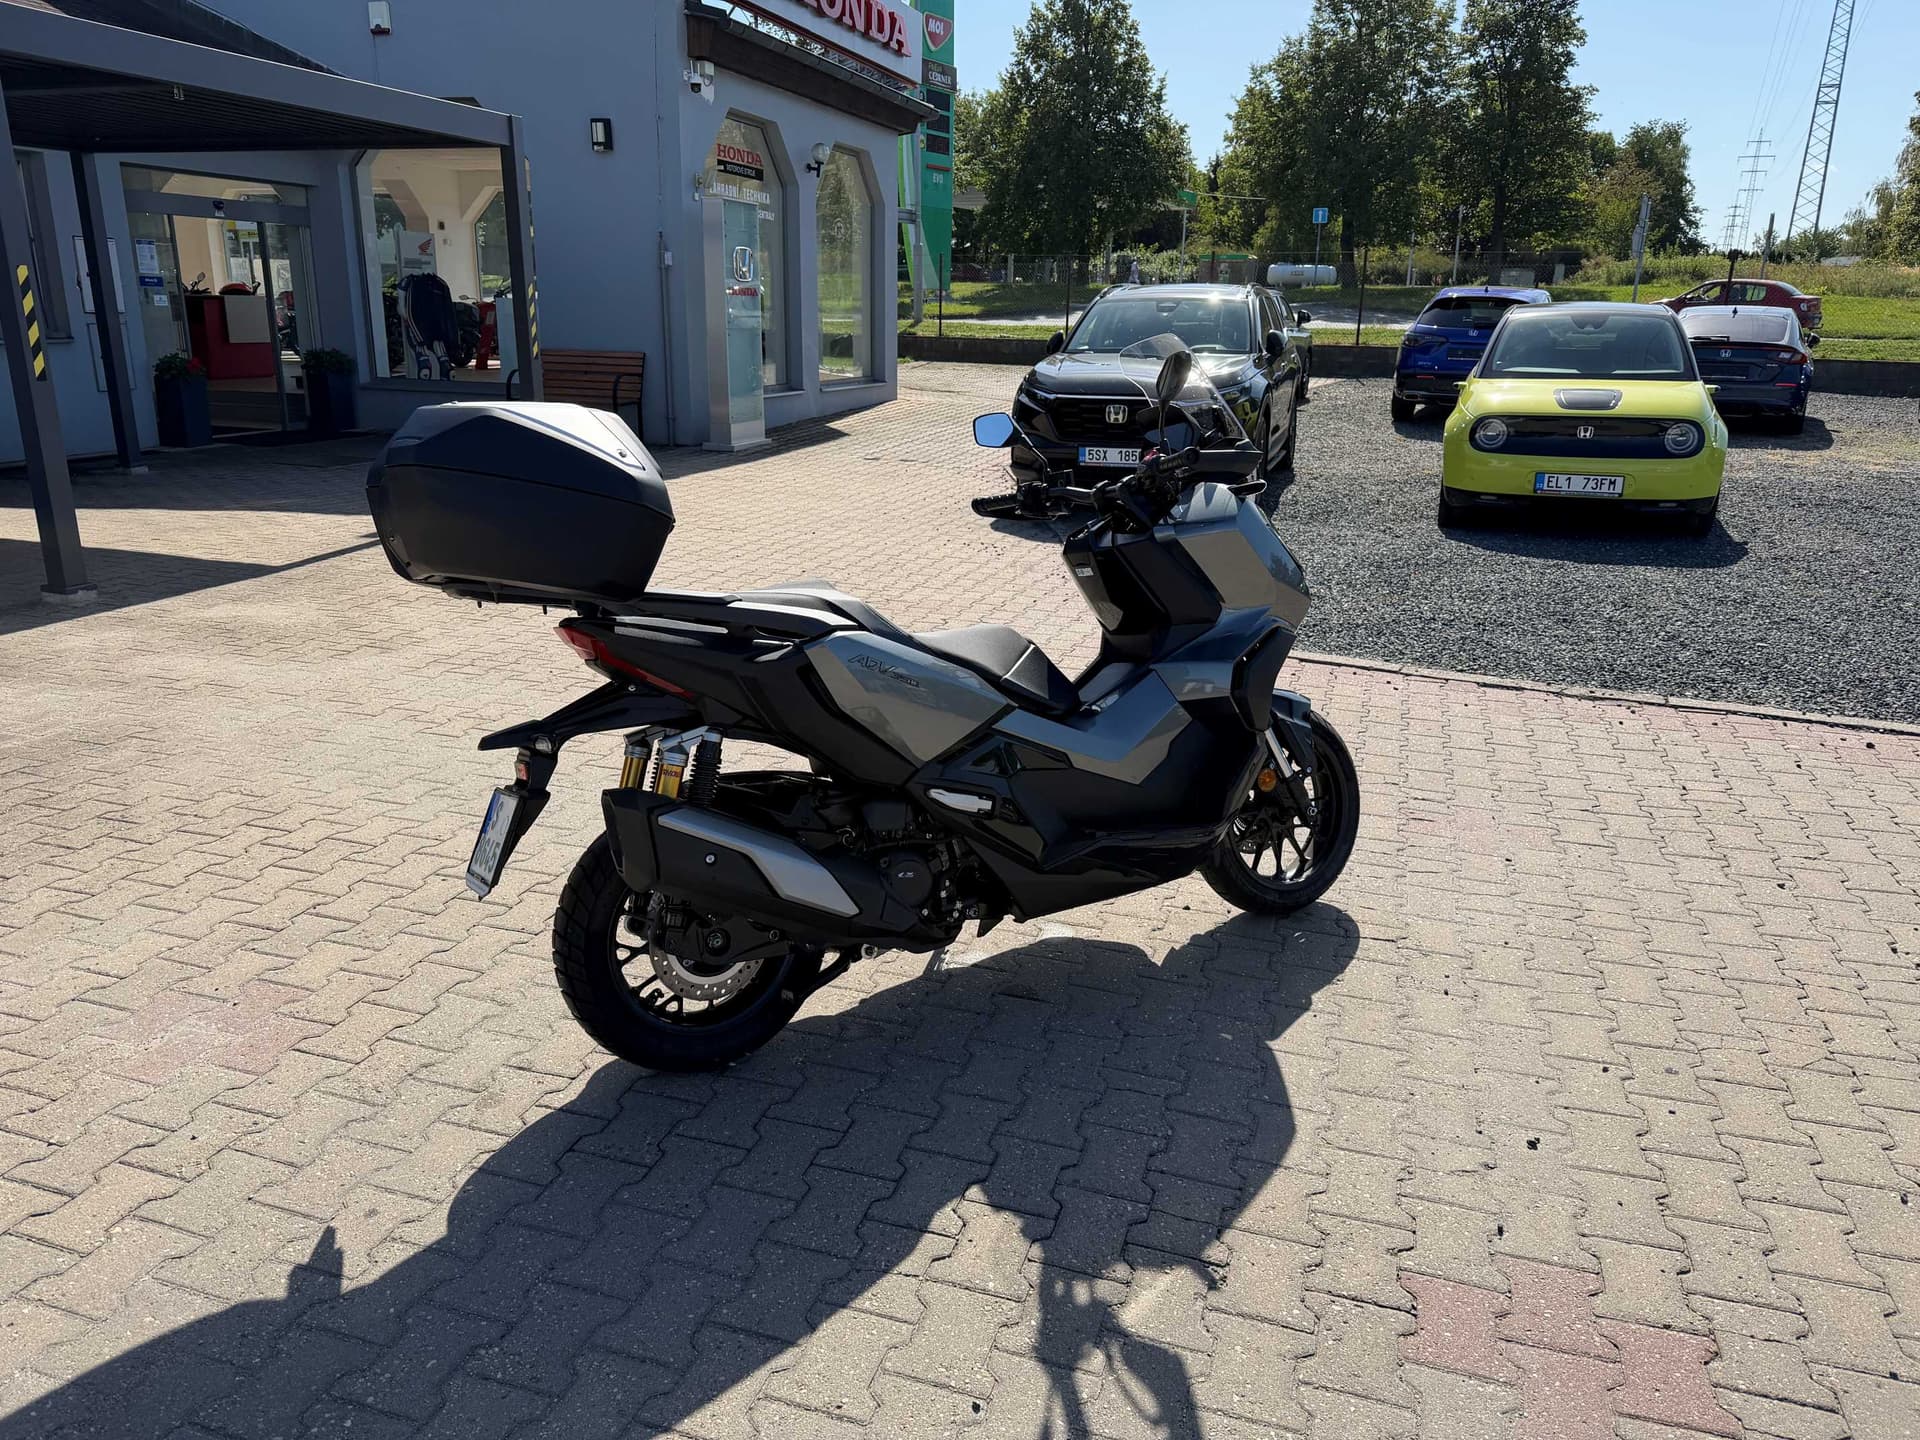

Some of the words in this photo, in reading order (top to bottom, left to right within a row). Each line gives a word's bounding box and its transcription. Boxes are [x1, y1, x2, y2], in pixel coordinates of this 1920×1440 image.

[798, 0, 911, 57] ONDA
[928, 18, 944, 35] MOL
[716, 144, 763, 166] HONDA
[1087, 448, 1108, 462] 5SX
[1117, 449, 1141, 463] 185
[1546, 475, 1572, 490] EL1
[1582, 477, 1617, 492] 73FM
